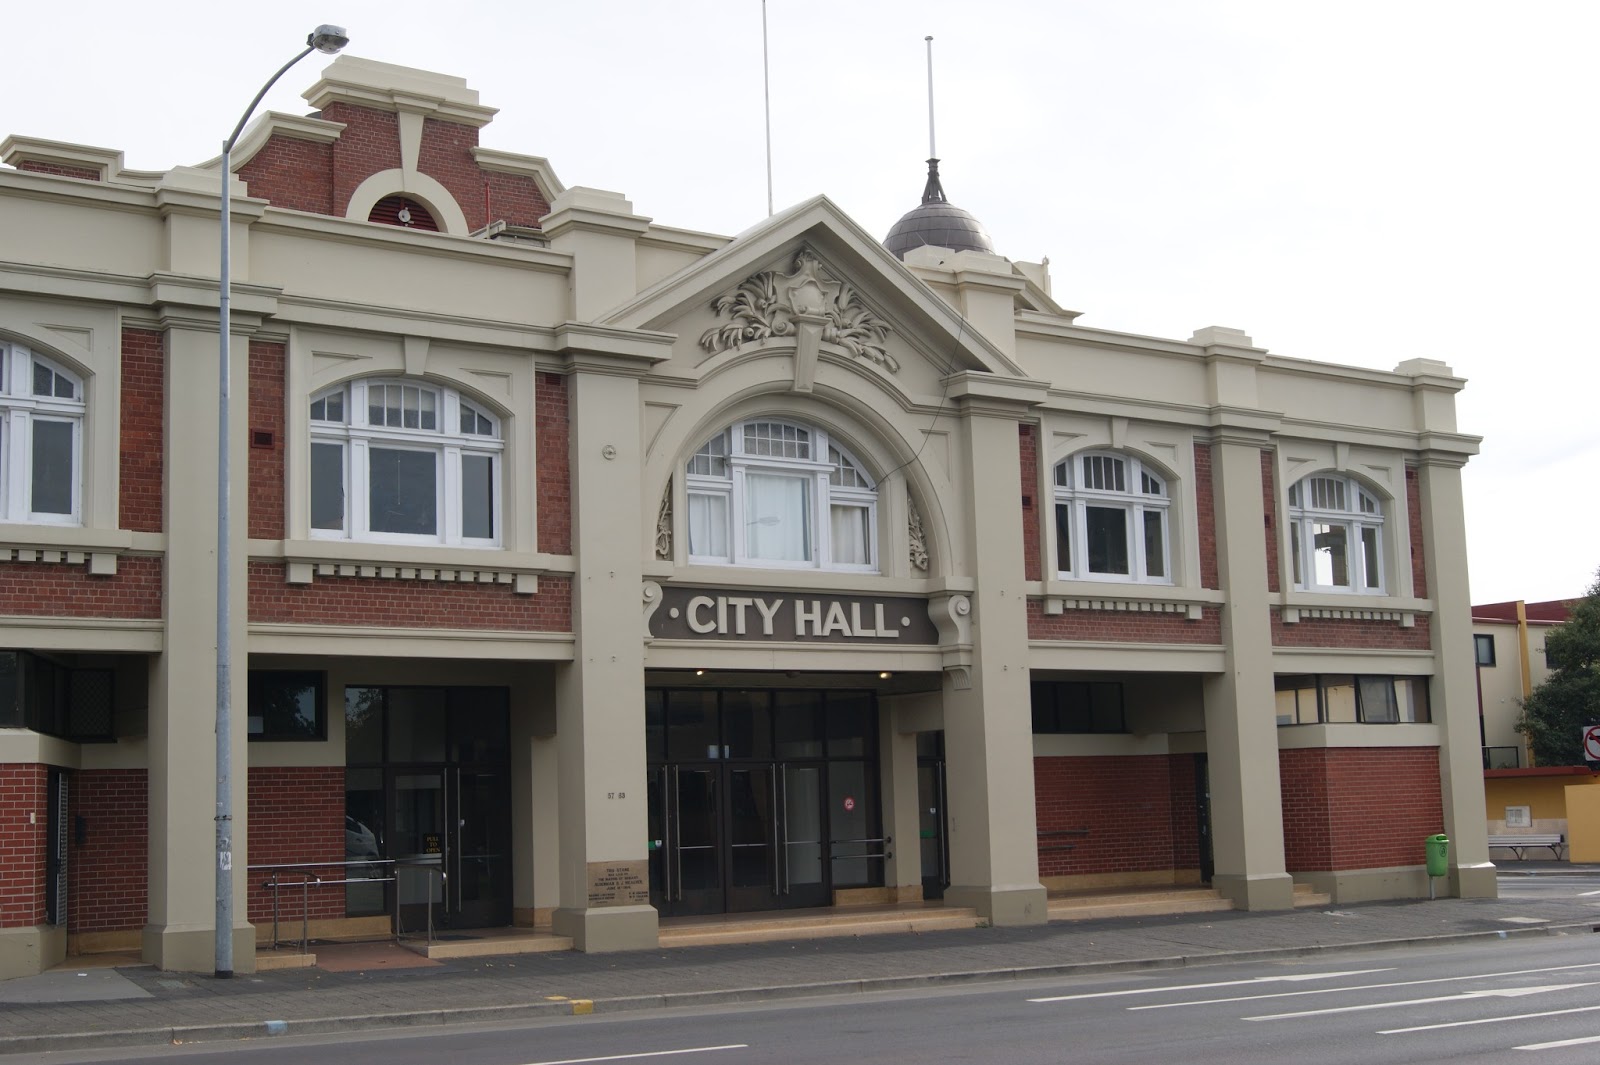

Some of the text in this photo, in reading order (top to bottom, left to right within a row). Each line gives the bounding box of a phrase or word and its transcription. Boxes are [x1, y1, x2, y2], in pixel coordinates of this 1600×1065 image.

[686, 595, 899, 637] CITY HALL
[608, 792, 615, 800] 57
